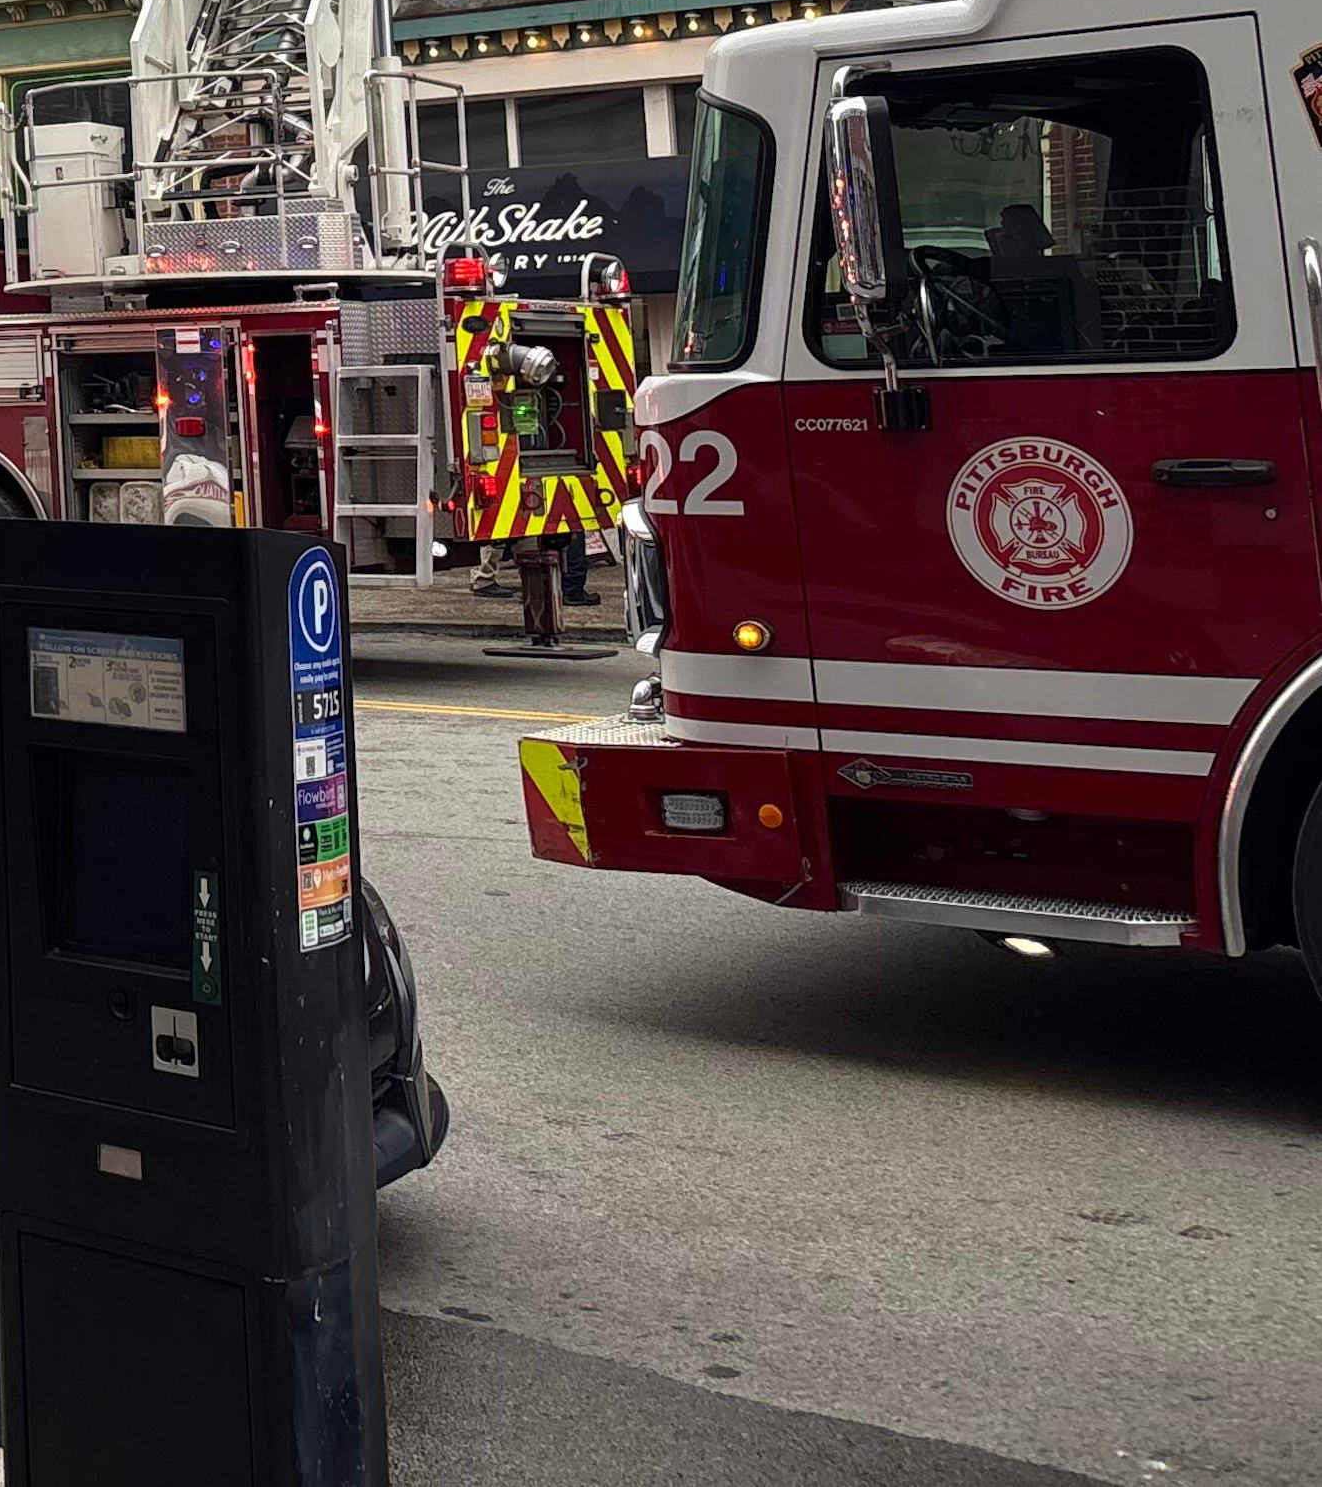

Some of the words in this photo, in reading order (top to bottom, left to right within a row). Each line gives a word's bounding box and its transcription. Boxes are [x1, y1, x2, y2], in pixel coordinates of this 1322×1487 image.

[483, 176, 516, 197] The
[794, 418, 868, 432] CC077621
[639, 430, 745, 516] 22
[955, 444, 1119, 511] PITTSBURGH
[1023, 486, 1045, 496] FIRE
[1026, 549, 1060, 559] BUREAU
[1001, 576, 1094, 603] FIRE
[39, 642, 71, 653] FOLLOW
[73, 645, 85, 653] ON
[313, 690, 340, 721] 5715
[194, 908, 218, 919] PRESS
[196, 917, 216, 927] HERE
[201, 925, 212, 933] TO
[194, 932, 219, 943] START
